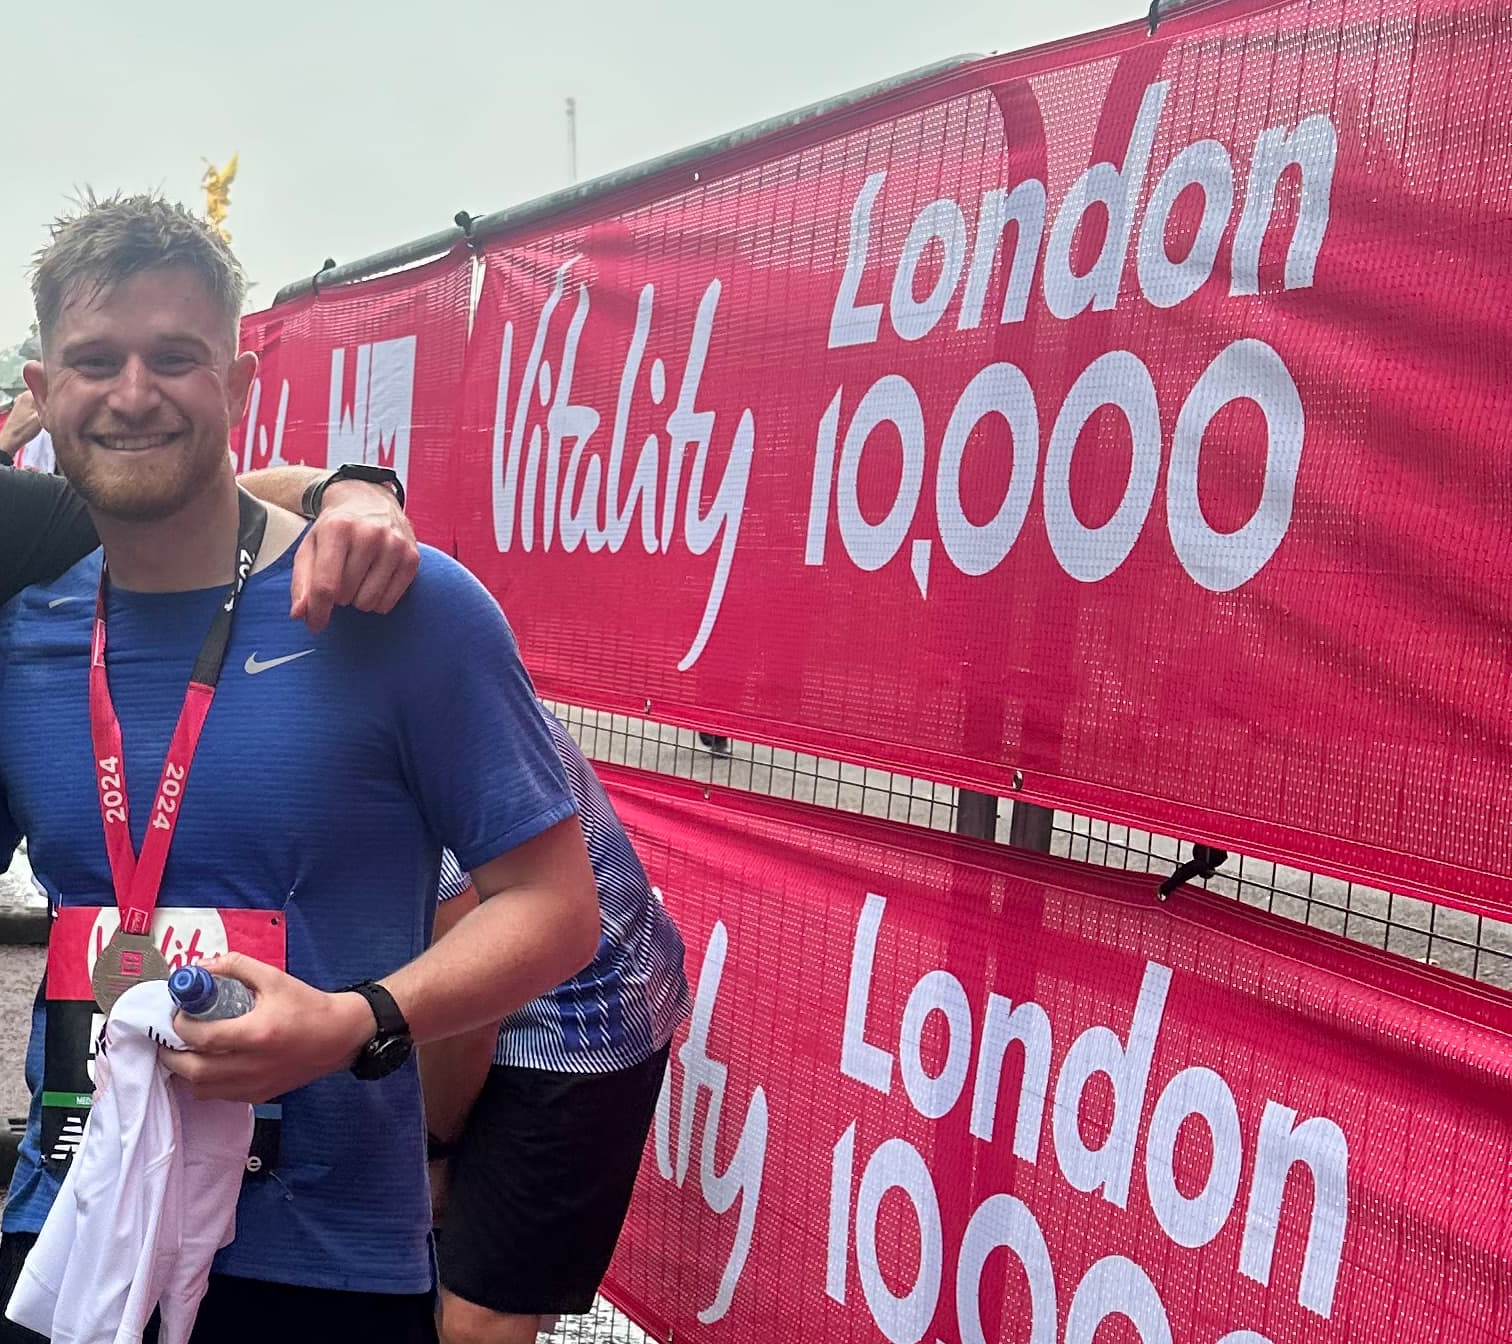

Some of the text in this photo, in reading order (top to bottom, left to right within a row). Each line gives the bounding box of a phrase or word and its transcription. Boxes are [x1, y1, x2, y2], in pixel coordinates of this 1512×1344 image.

[827, 80, 1337, 349] London
[491, 254, 754, 672] Vitality
[804, 337, 1305, 601] 10,000
[99, 756, 127, 823] 2024
[152, 763, 184, 830] 2024
[840, 893, 1349, 1319] London
